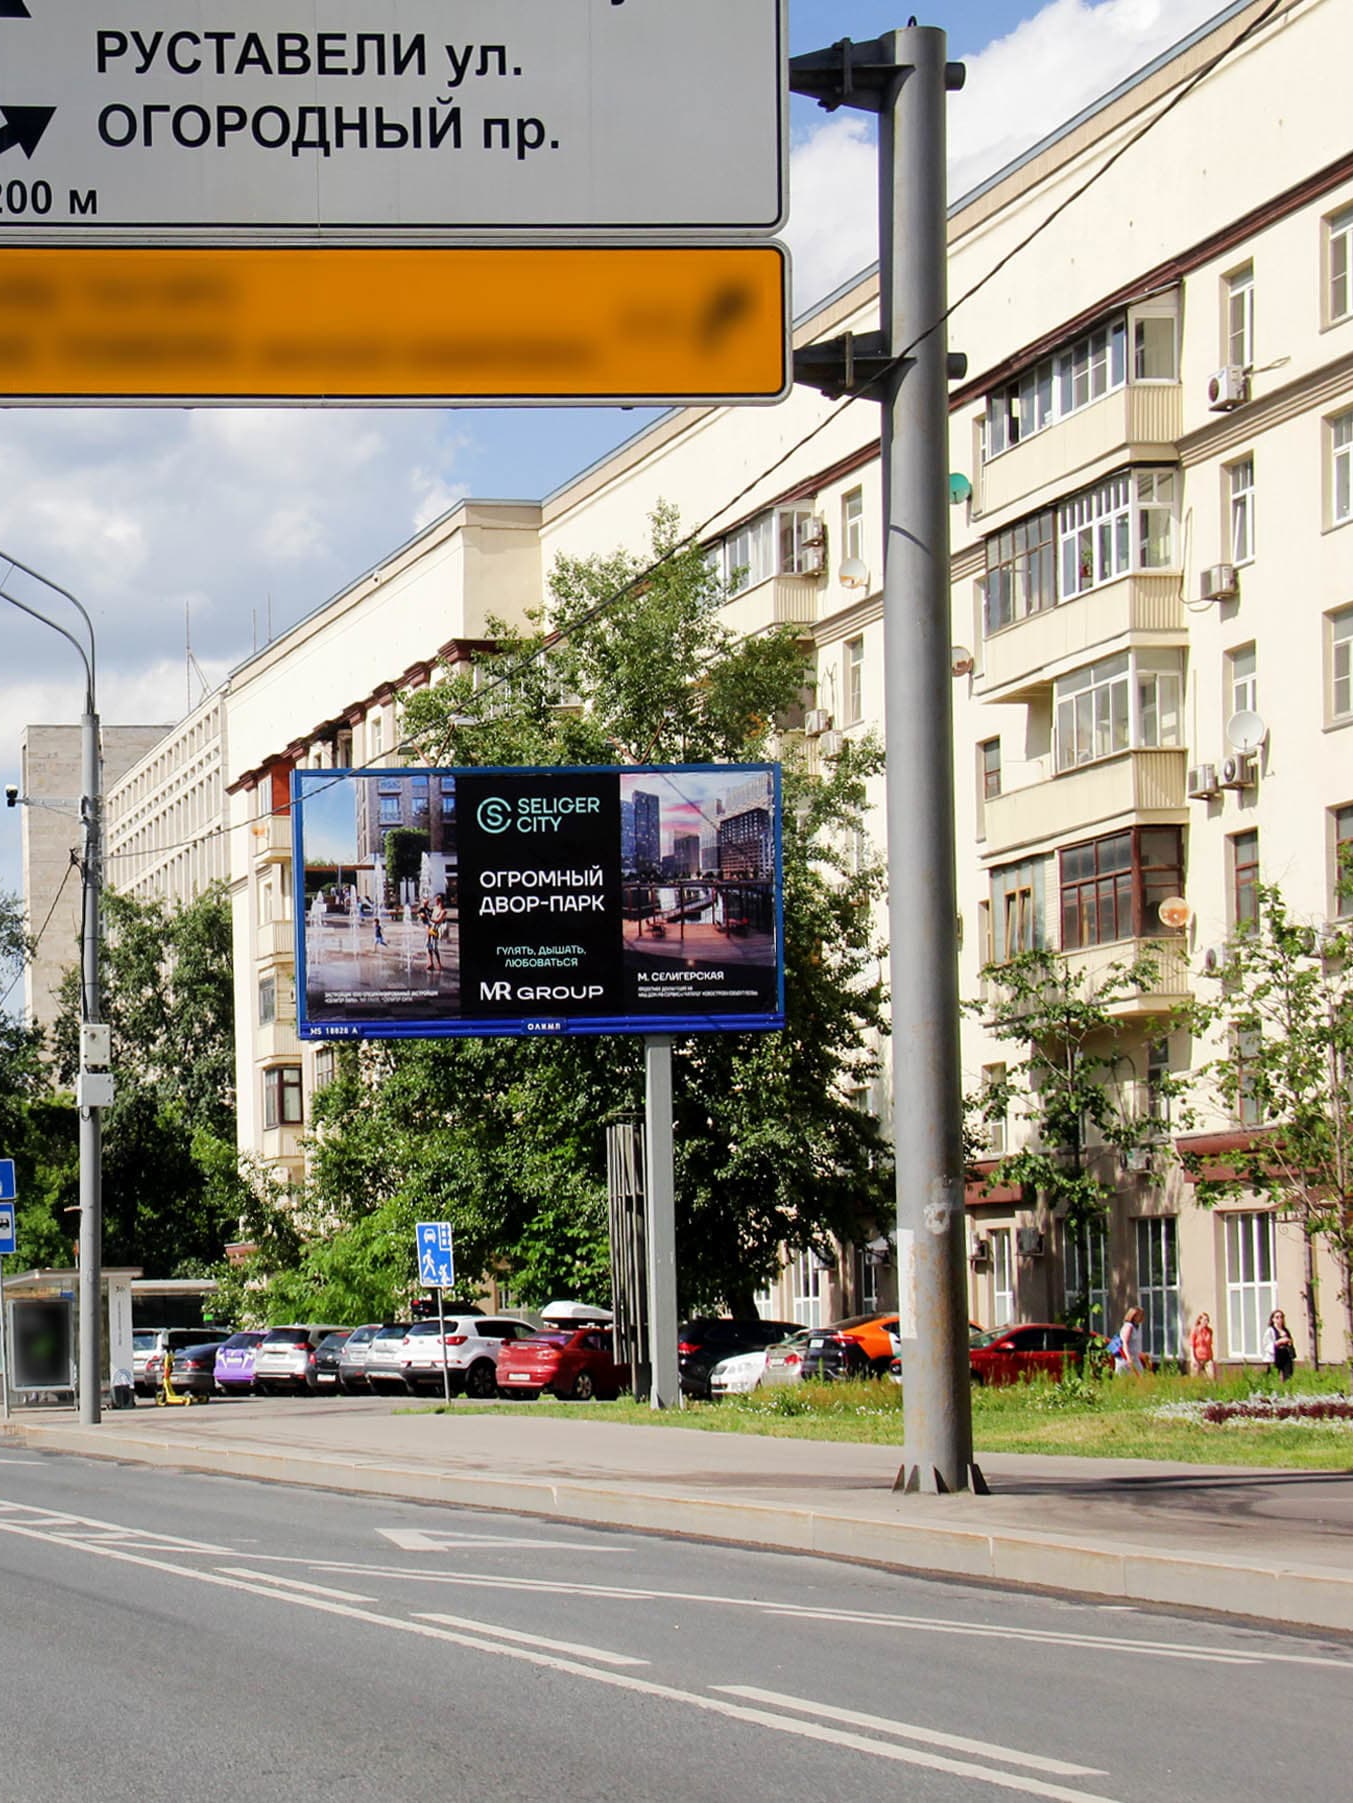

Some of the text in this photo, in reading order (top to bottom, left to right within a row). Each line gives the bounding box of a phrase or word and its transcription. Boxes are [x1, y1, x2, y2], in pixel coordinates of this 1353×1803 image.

[96, 31, 523, 88] РУСТАВЕЛИ ул.
[98, 96, 560, 161] ОГОРОДНЫЙ пр.
[69, 189, 98, 215] м
[517, 797, 601, 814] SELIGER
[516, 816, 562, 833] CITY
[479, 864, 604, 888] ОГРОМНЫЙ
[478, 894, 605, 916] ДВОР-ПАРК
[496, 945, 537, 956] ГУЛЯТЬ,
[504, 957, 579, 968] ЛЮБОВАТЬСЯ
[651, 970, 725, 982] СЕЛИГЕРСКАЯ
[480, 981, 604, 1001] MR GROUP
